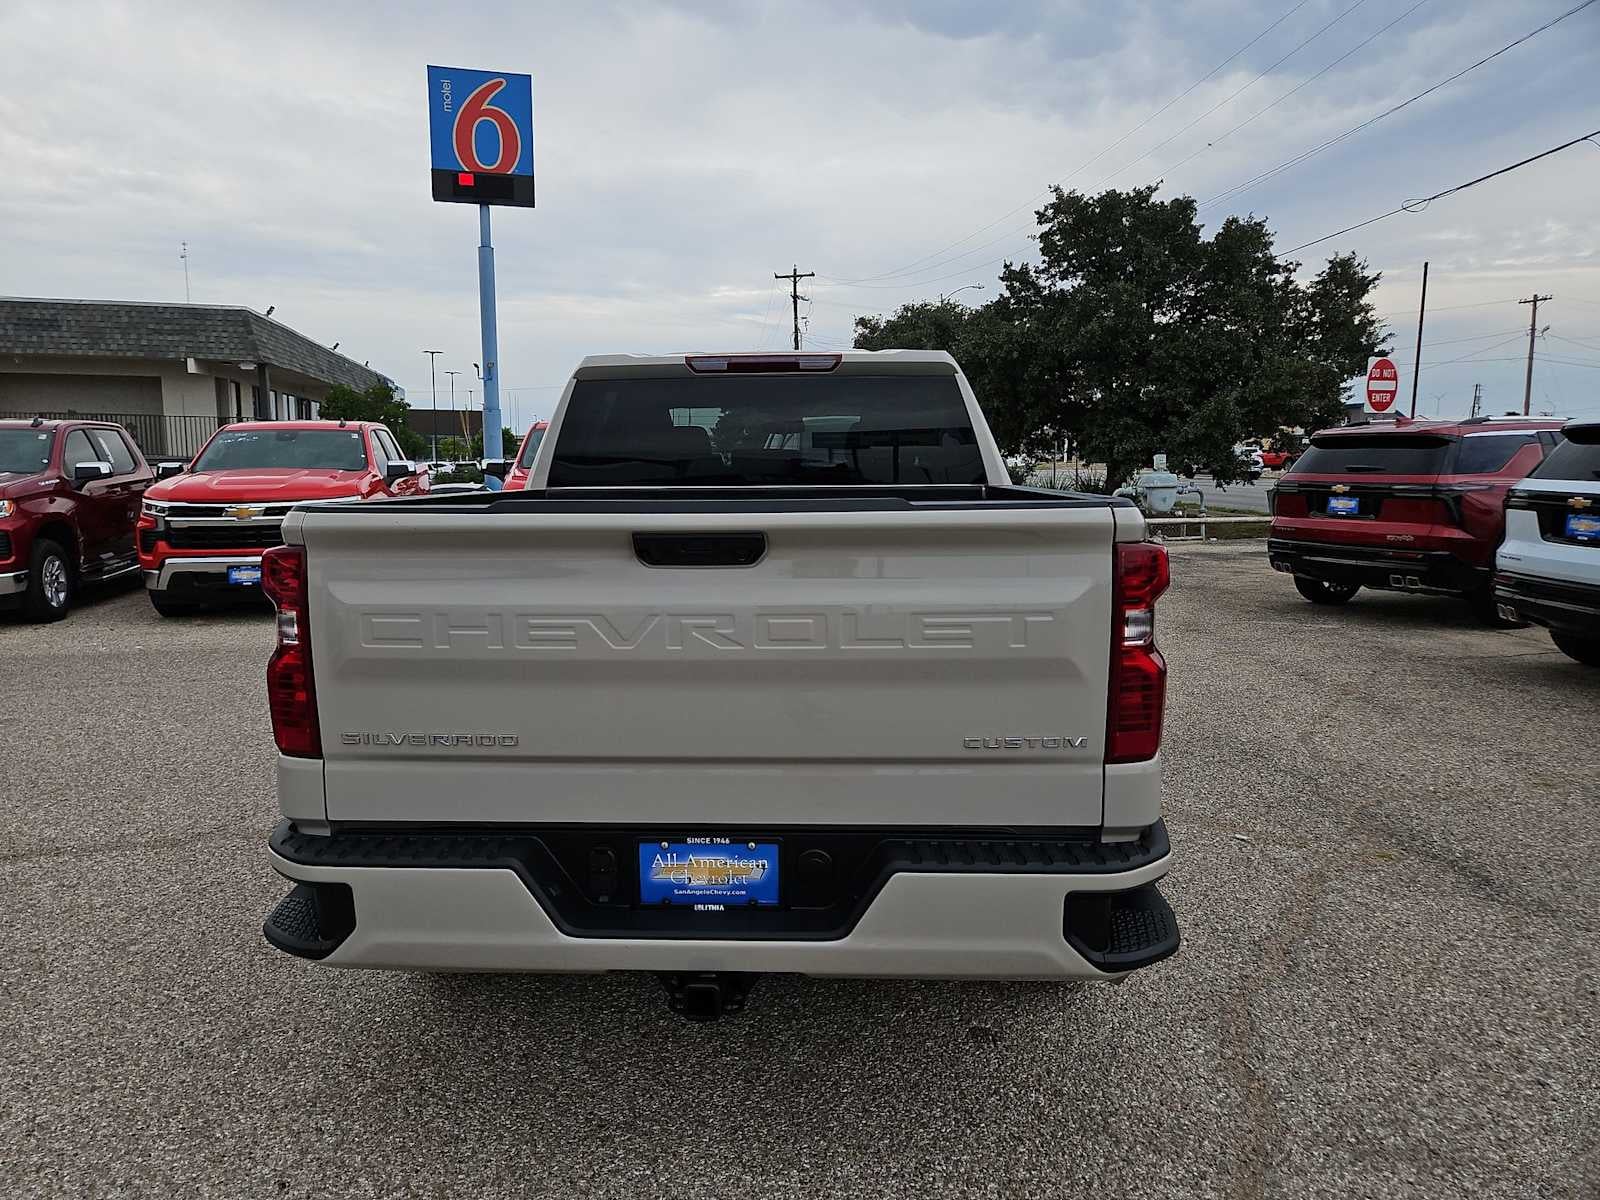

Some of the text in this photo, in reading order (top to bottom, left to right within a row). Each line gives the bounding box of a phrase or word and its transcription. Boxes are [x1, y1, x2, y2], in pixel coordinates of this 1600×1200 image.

[440, 80, 452, 112] motel
[452, 77, 521, 174] 6
[1371, 368, 1395, 378] DO NOT
[1371, 393, 1391, 402] ENTER
[360, 612, 1055, 650] CHEVROLET
[341, 731, 520, 748] SILVERADO
[963, 735, 1088, 750] CUSTOM
[686, 837, 711, 845] SINCE
[651, 853, 769, 869] All American
[670, 869, 748, 885] Chevrolet
